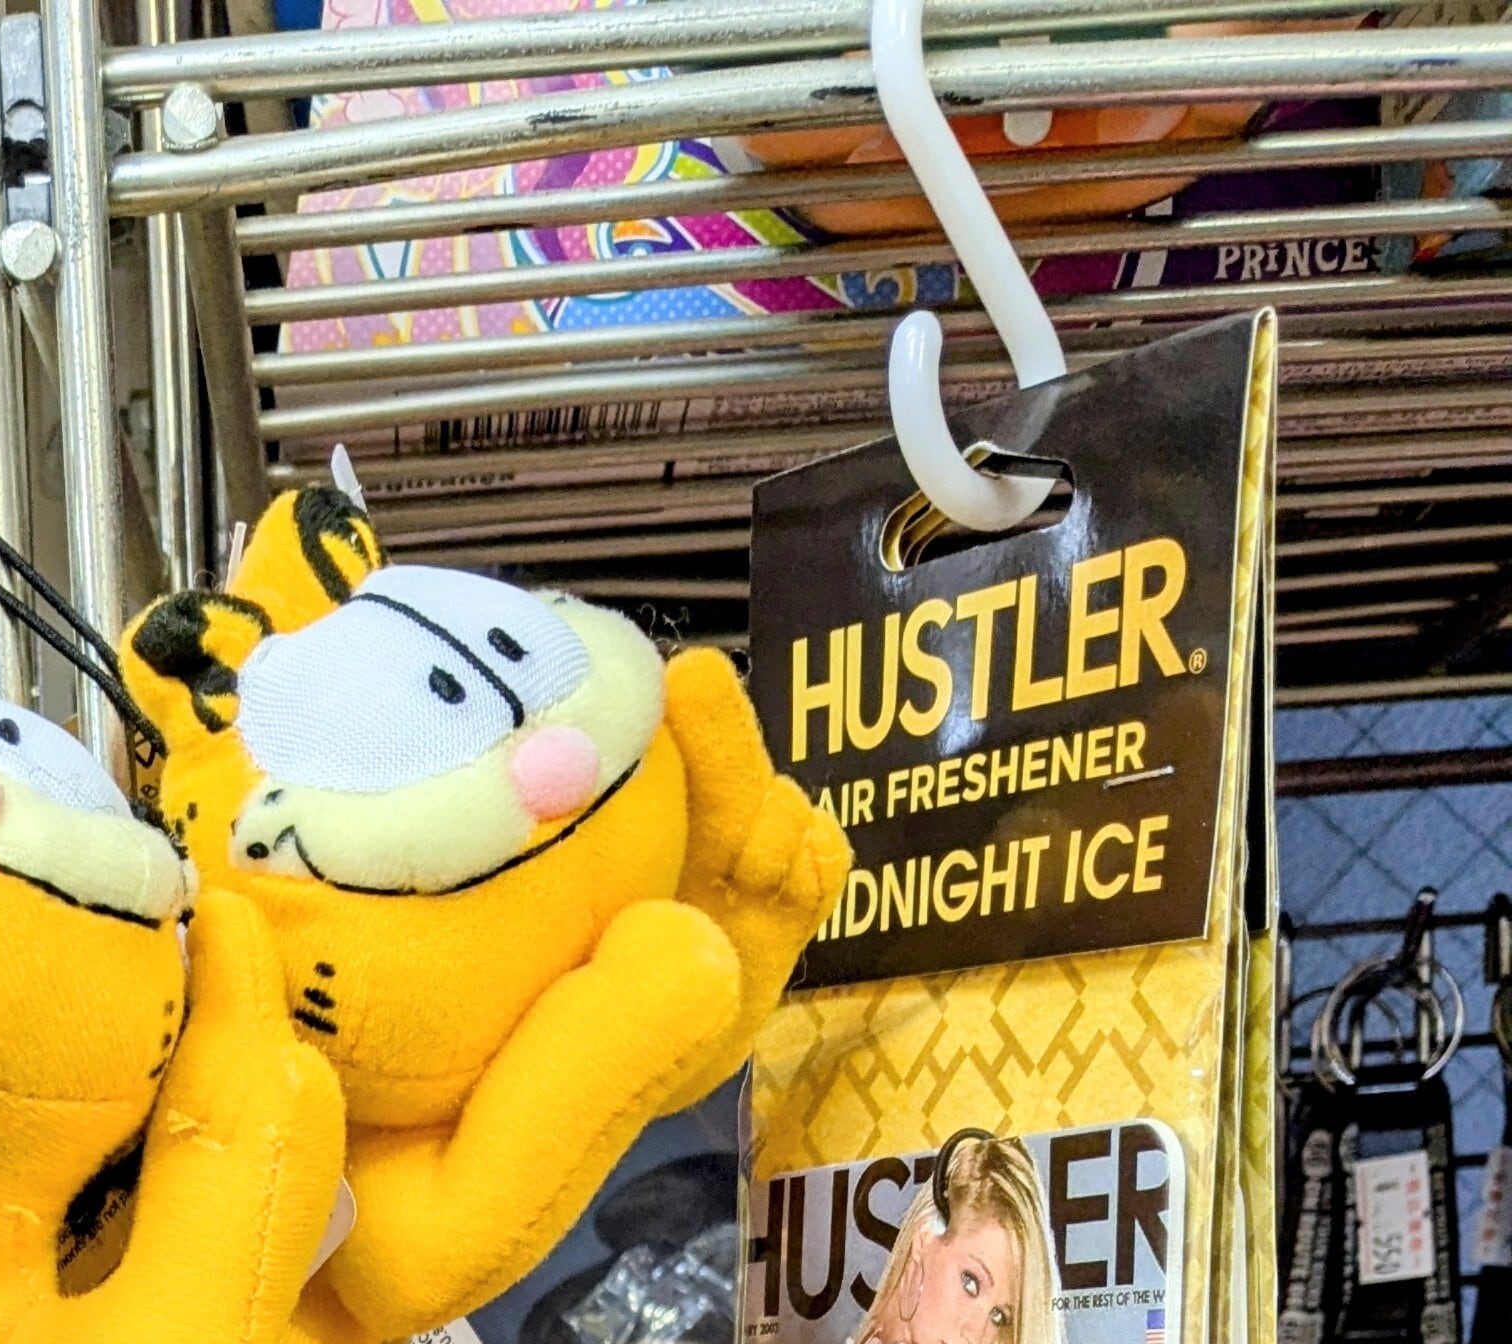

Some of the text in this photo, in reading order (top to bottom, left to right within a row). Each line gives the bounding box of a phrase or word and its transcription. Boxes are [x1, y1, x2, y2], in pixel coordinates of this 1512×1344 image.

[887, 721, 1147, 819] FRESHENER
[817, 814, 1169, 942] IDNIGHT ICE
[748, 1125, 1169, 1321] HUSER
[1051, 1296, 1070, 1312] FOR
[1072, 1295, 1090, 1309] THE
[1116, 1291, 1130, 1306] OF
[1133, 1289, 1150, 1305] THE
